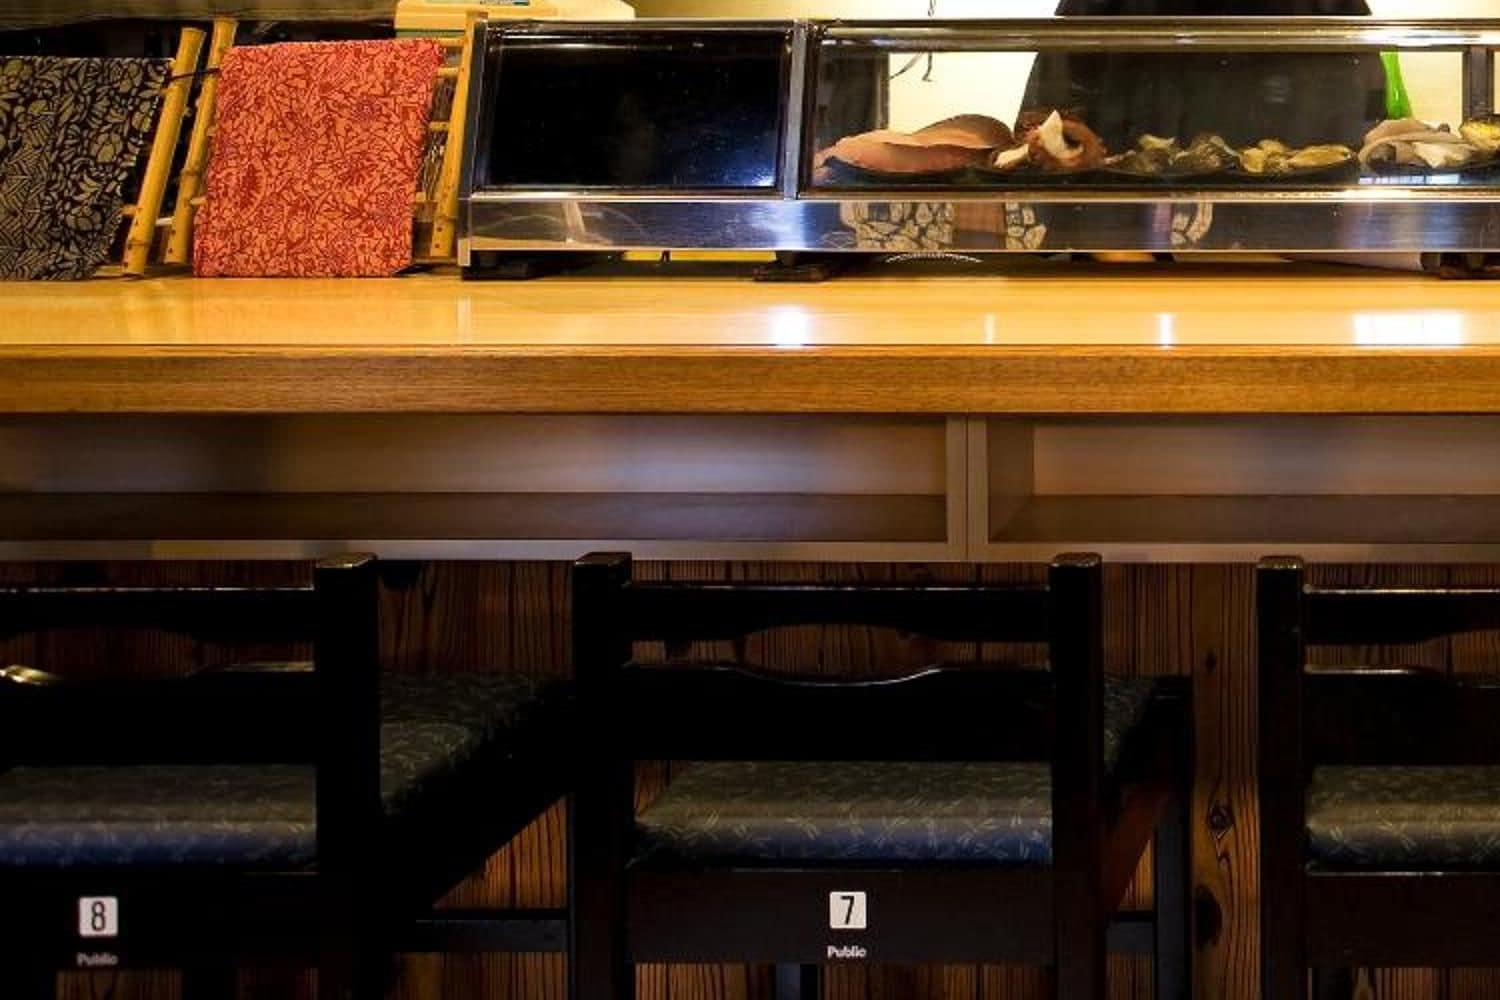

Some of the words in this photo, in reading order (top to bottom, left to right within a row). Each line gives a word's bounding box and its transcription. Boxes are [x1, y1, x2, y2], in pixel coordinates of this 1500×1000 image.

[92, 901, 105, 931] 8
[840, 896, 854, 925] 7
[827, 945, 867, 959] Public
